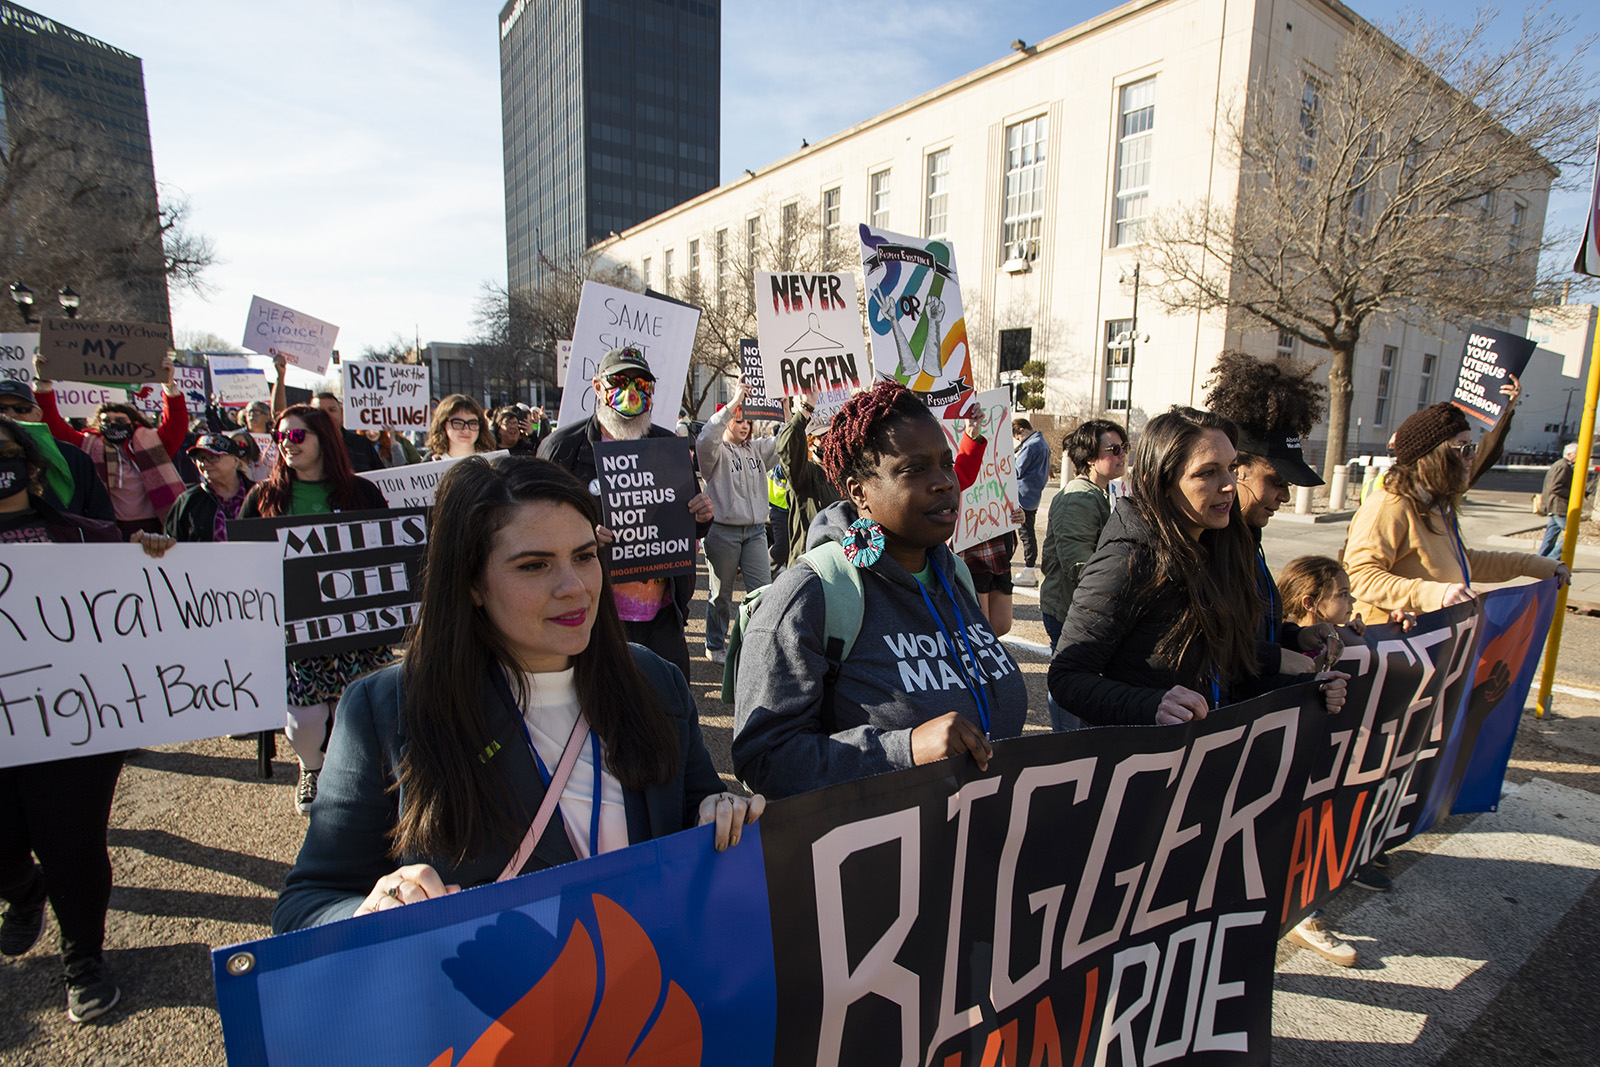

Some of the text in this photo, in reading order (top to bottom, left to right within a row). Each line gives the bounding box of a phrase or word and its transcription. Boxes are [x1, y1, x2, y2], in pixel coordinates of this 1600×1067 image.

[770, 274, 847, 315] NEVER
[260, 305, 295, 324] HER
[604, 298, 664, 337] SAME
[899, 295, 921, 321] OR
[81, 338, 126, 361] MY
[743, 346, 760, 356] NO
[1468, 333, 1497, 350] NOT
[1466, 344, 1499, 364] YOUR
[83, 361, 156, 379] HANDS
[182, 367, 203, 378] LET
[348, 364, 426, 390] ROE was the
[745, 367, 764, 376] UTE
[780, 353, 860, 397] AGAIN
[1459, 366, 1483, 383] NOT
[1462, 355, 1507, 379] UTERUS
[175, 379, 204, 390] TION
[388, 379, 423, 397] floor
[1458, 377, 1486, 397] YOUR
[56, 389, 110, 405] HOICE
[351, 393, 369, 408] not
[745, 397, 783, 410] DECISION
[1454, 387, 1502, 416] DECISION
[360, 404, 428, 428] CEILING!
[602, 454, 639, 472] NOT
[605, 471, 655, 490] YOUR
[608, 488, 676, 508] UTERUS
[610, 509, 646, 527] NOT
[965, 501, 1015, 540] BODY
[284, 517, 424, 558] MITTS
[612, 525, 659, 543] YOUR
[612, 538, 689, 561] DECISION
[610, 560, 692, 577] BIGGERTHANROE.COM
[320, 563, 405, 600] OFF
[0, 562, 280, 643] Rural Women
[897, 643, 1016, 693] MARCH
[0, 659, 259, 746] Fight Back
[811, 706, 1300, 1067] BIGGER
[1092, 909, 1267, 1067] ROE
